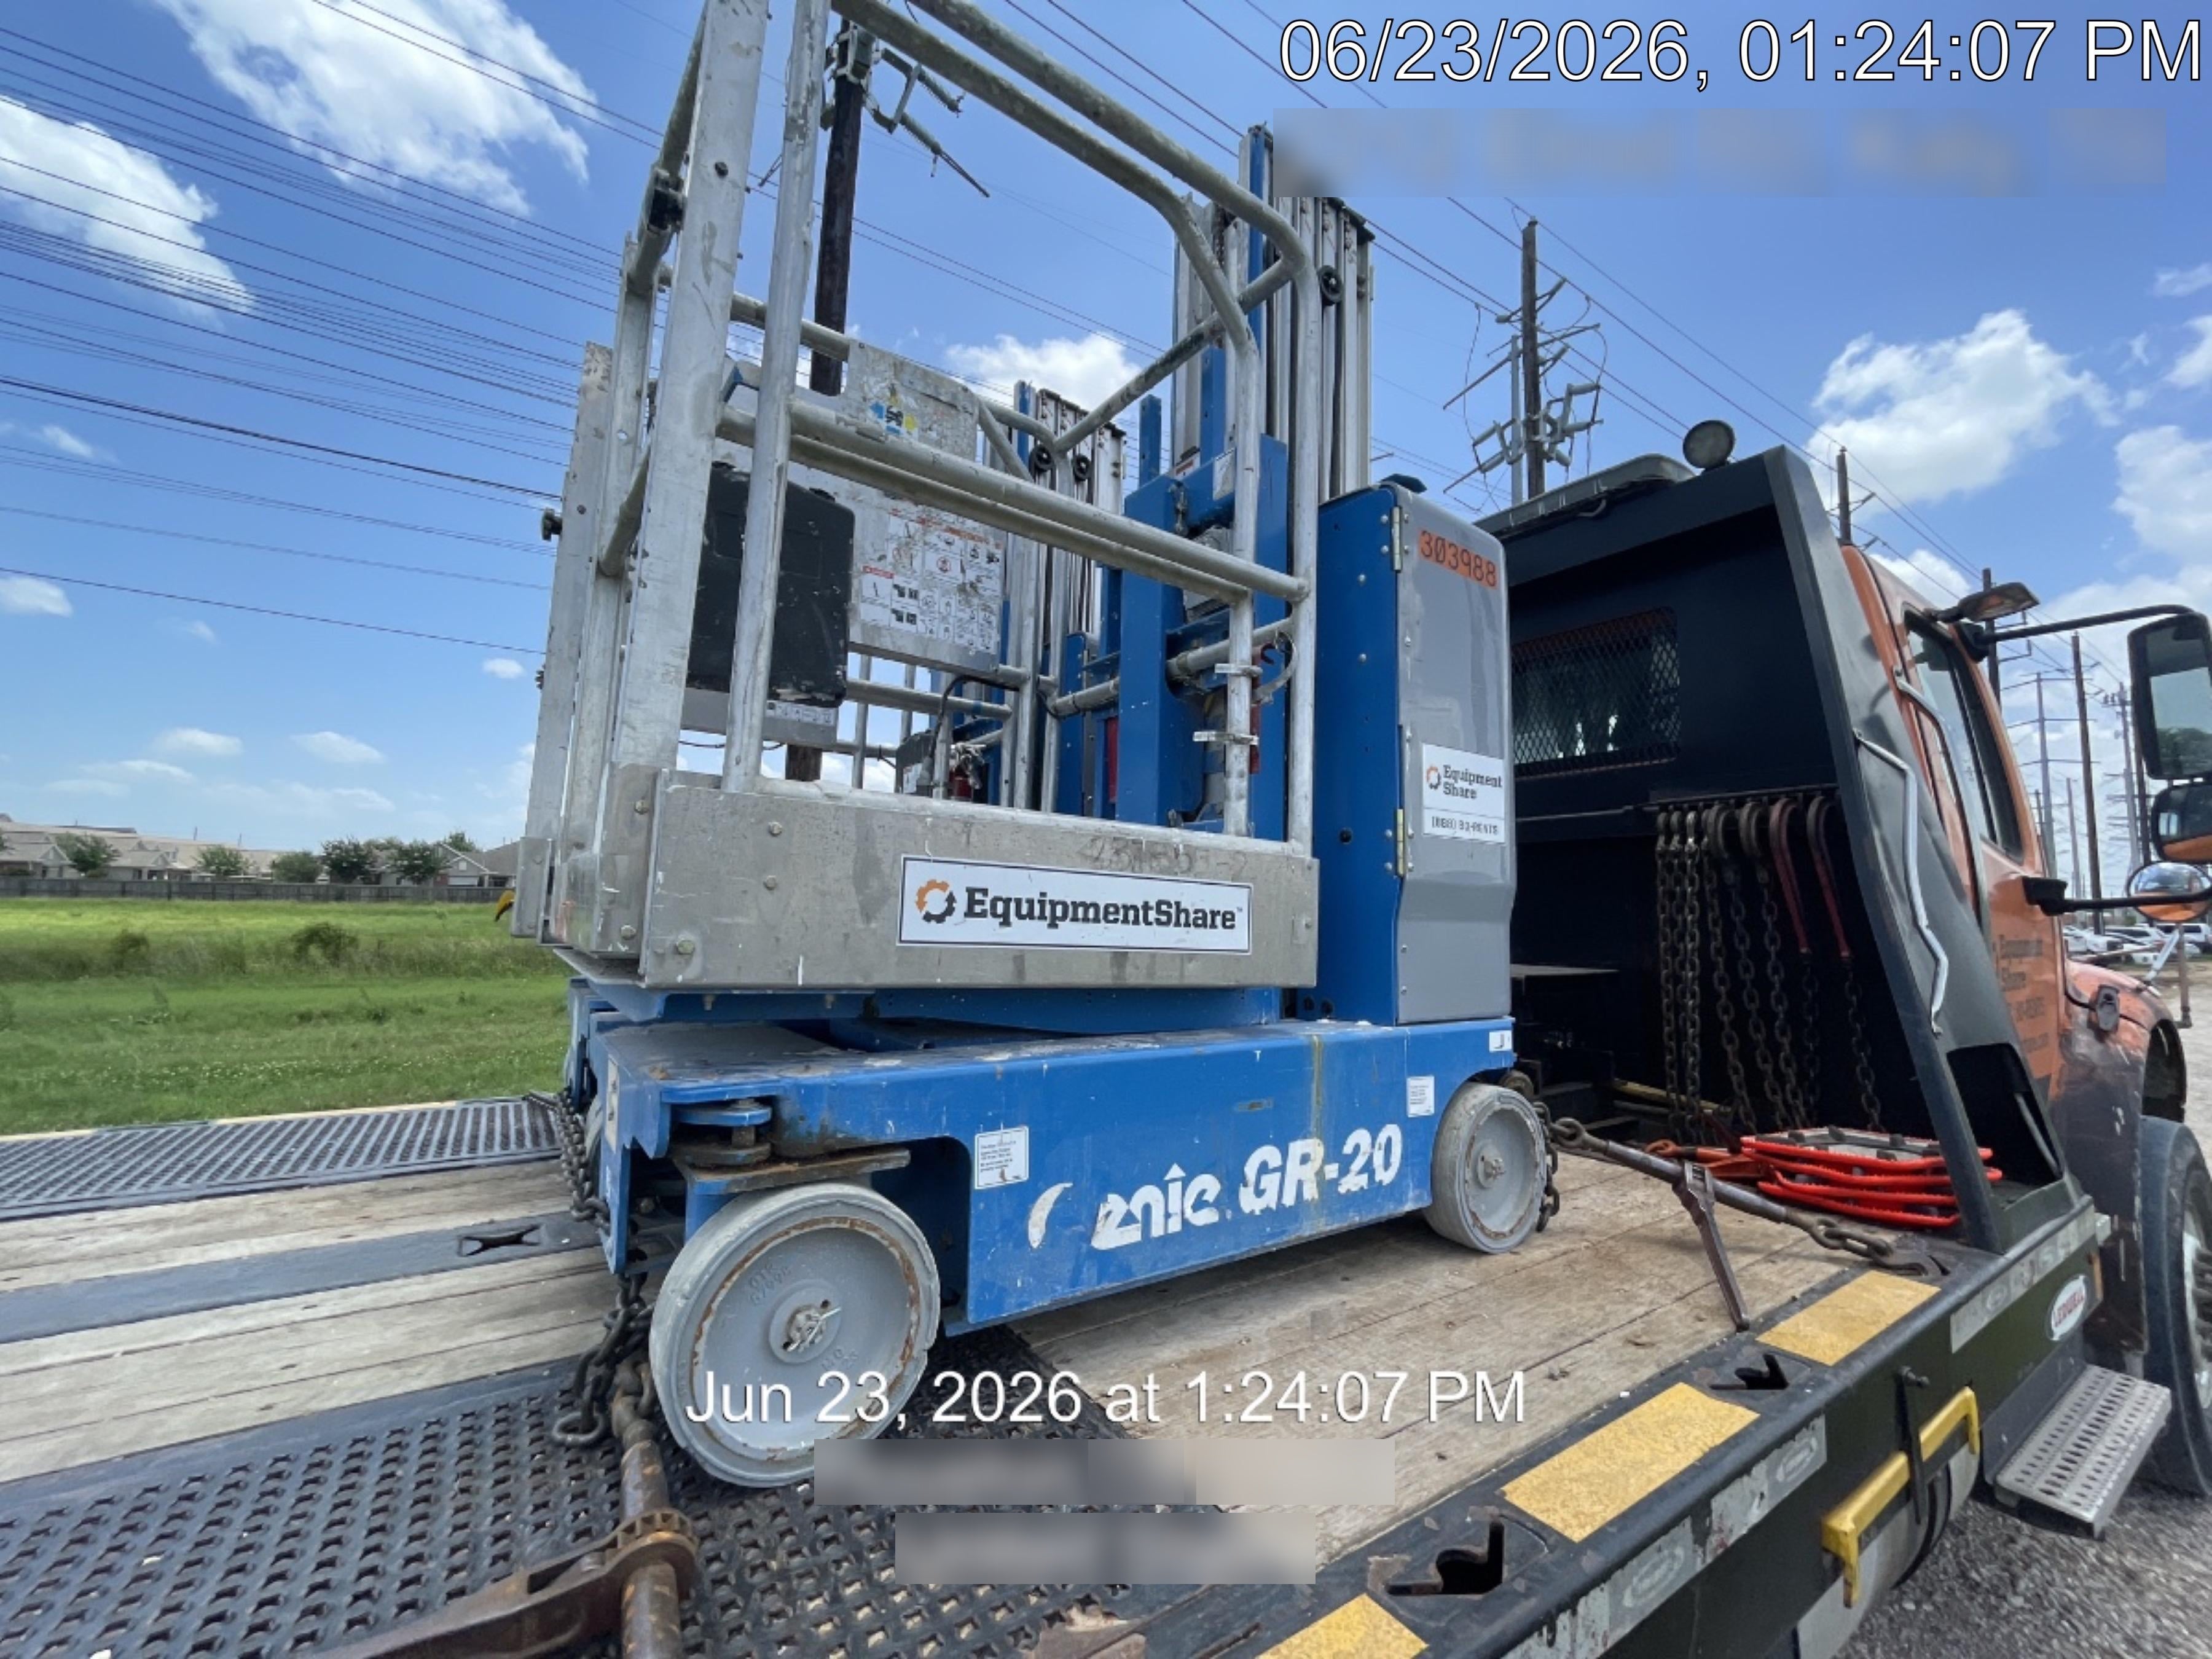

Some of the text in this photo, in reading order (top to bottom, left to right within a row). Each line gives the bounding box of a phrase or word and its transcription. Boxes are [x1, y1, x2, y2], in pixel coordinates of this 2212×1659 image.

[1421, 530, 1496, 587] 303988
[1443, 764, 1502, 788] Equipment
[1443, 781, 1477, 799] Share
[963, 886, 1236, 930] EquipmentShare
[1239, 1124, 1403, 1216] GR-20
